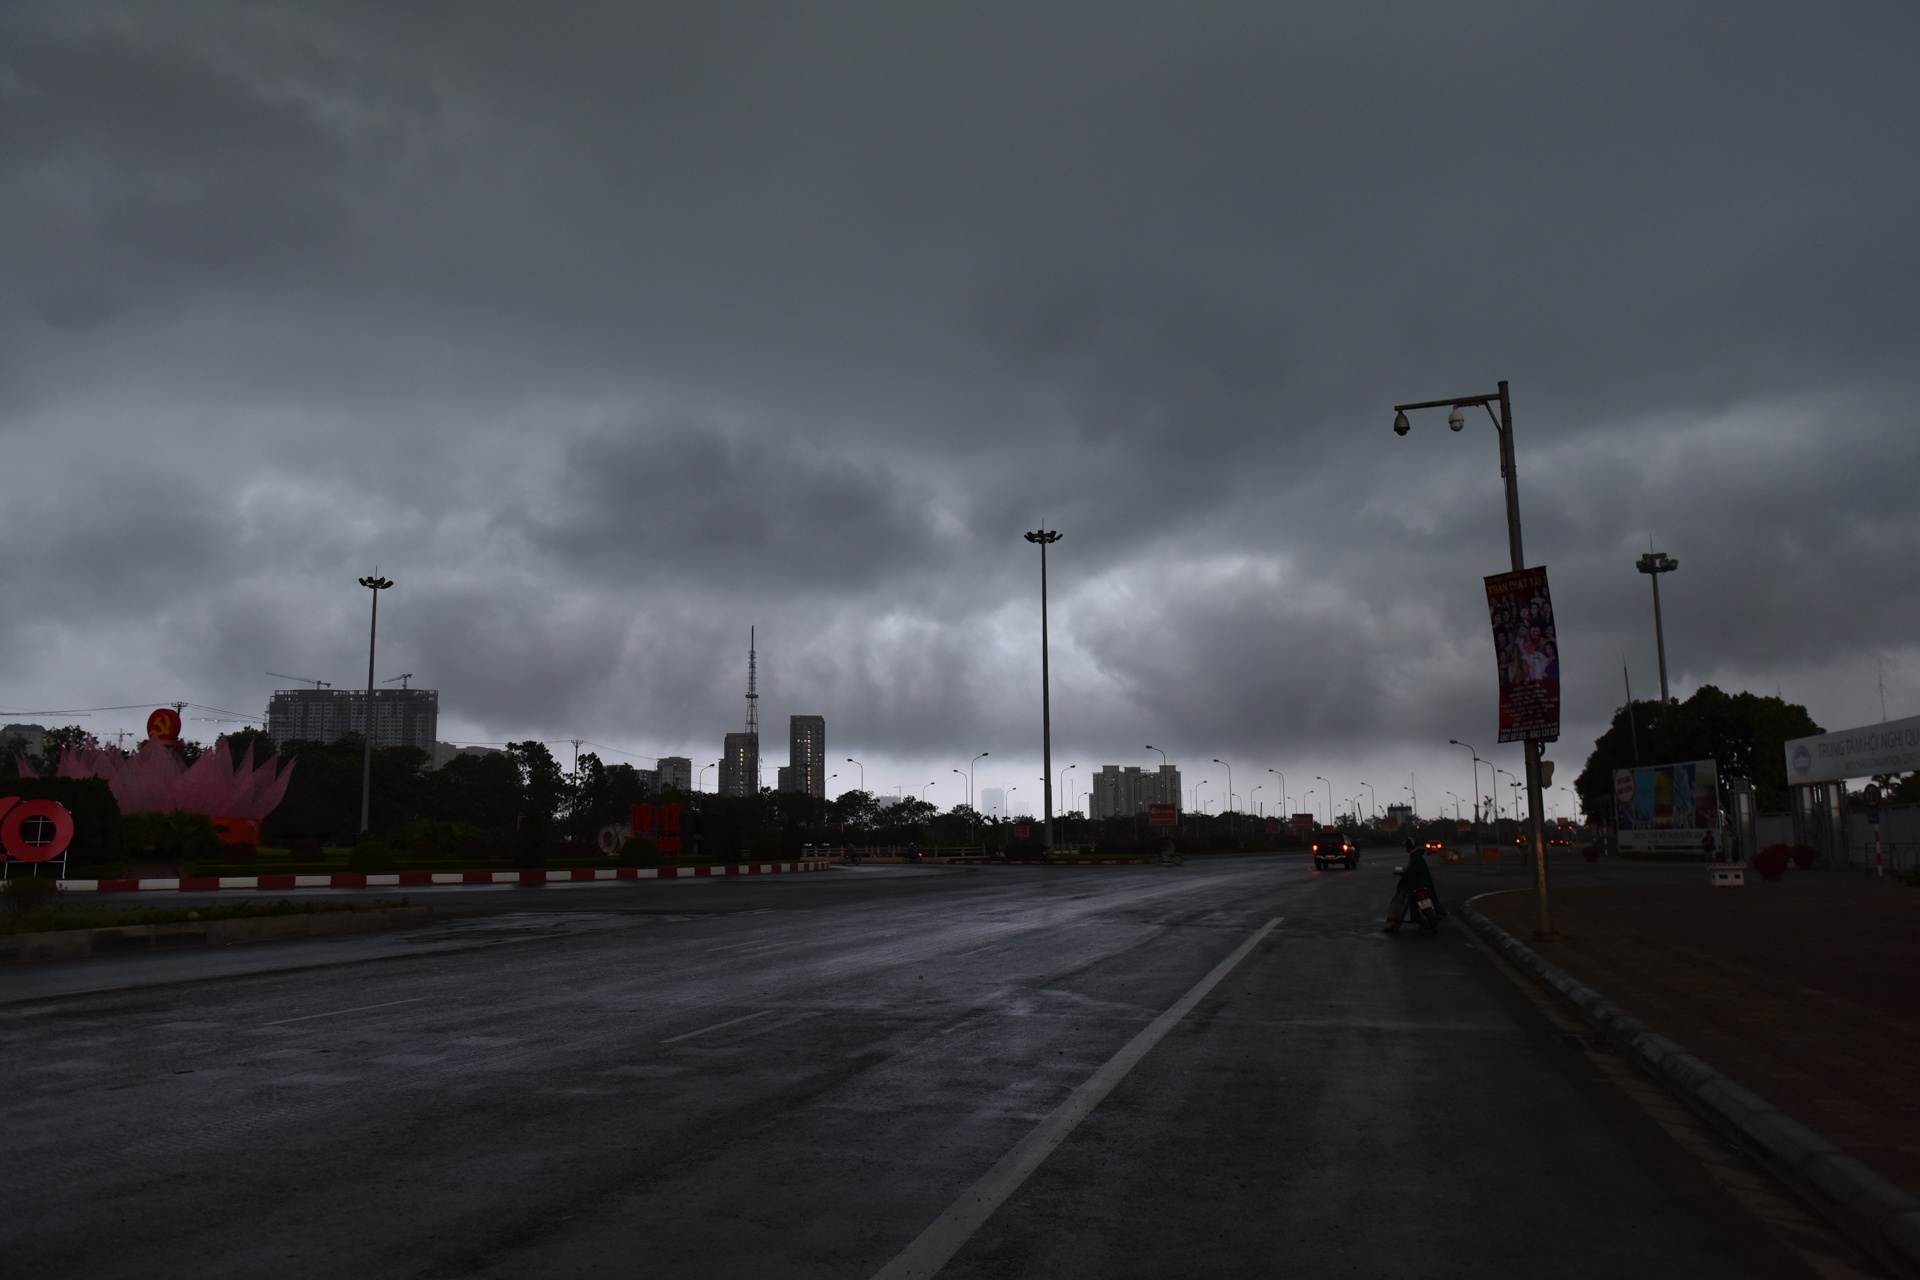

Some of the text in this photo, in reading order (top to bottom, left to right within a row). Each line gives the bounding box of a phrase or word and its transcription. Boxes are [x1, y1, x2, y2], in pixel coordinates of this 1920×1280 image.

[1818, 740, 1845, 758] TRUNG
[1845, 736, 1863, 755] TÂM
[1864, 731, 1879, 755] HỘI
